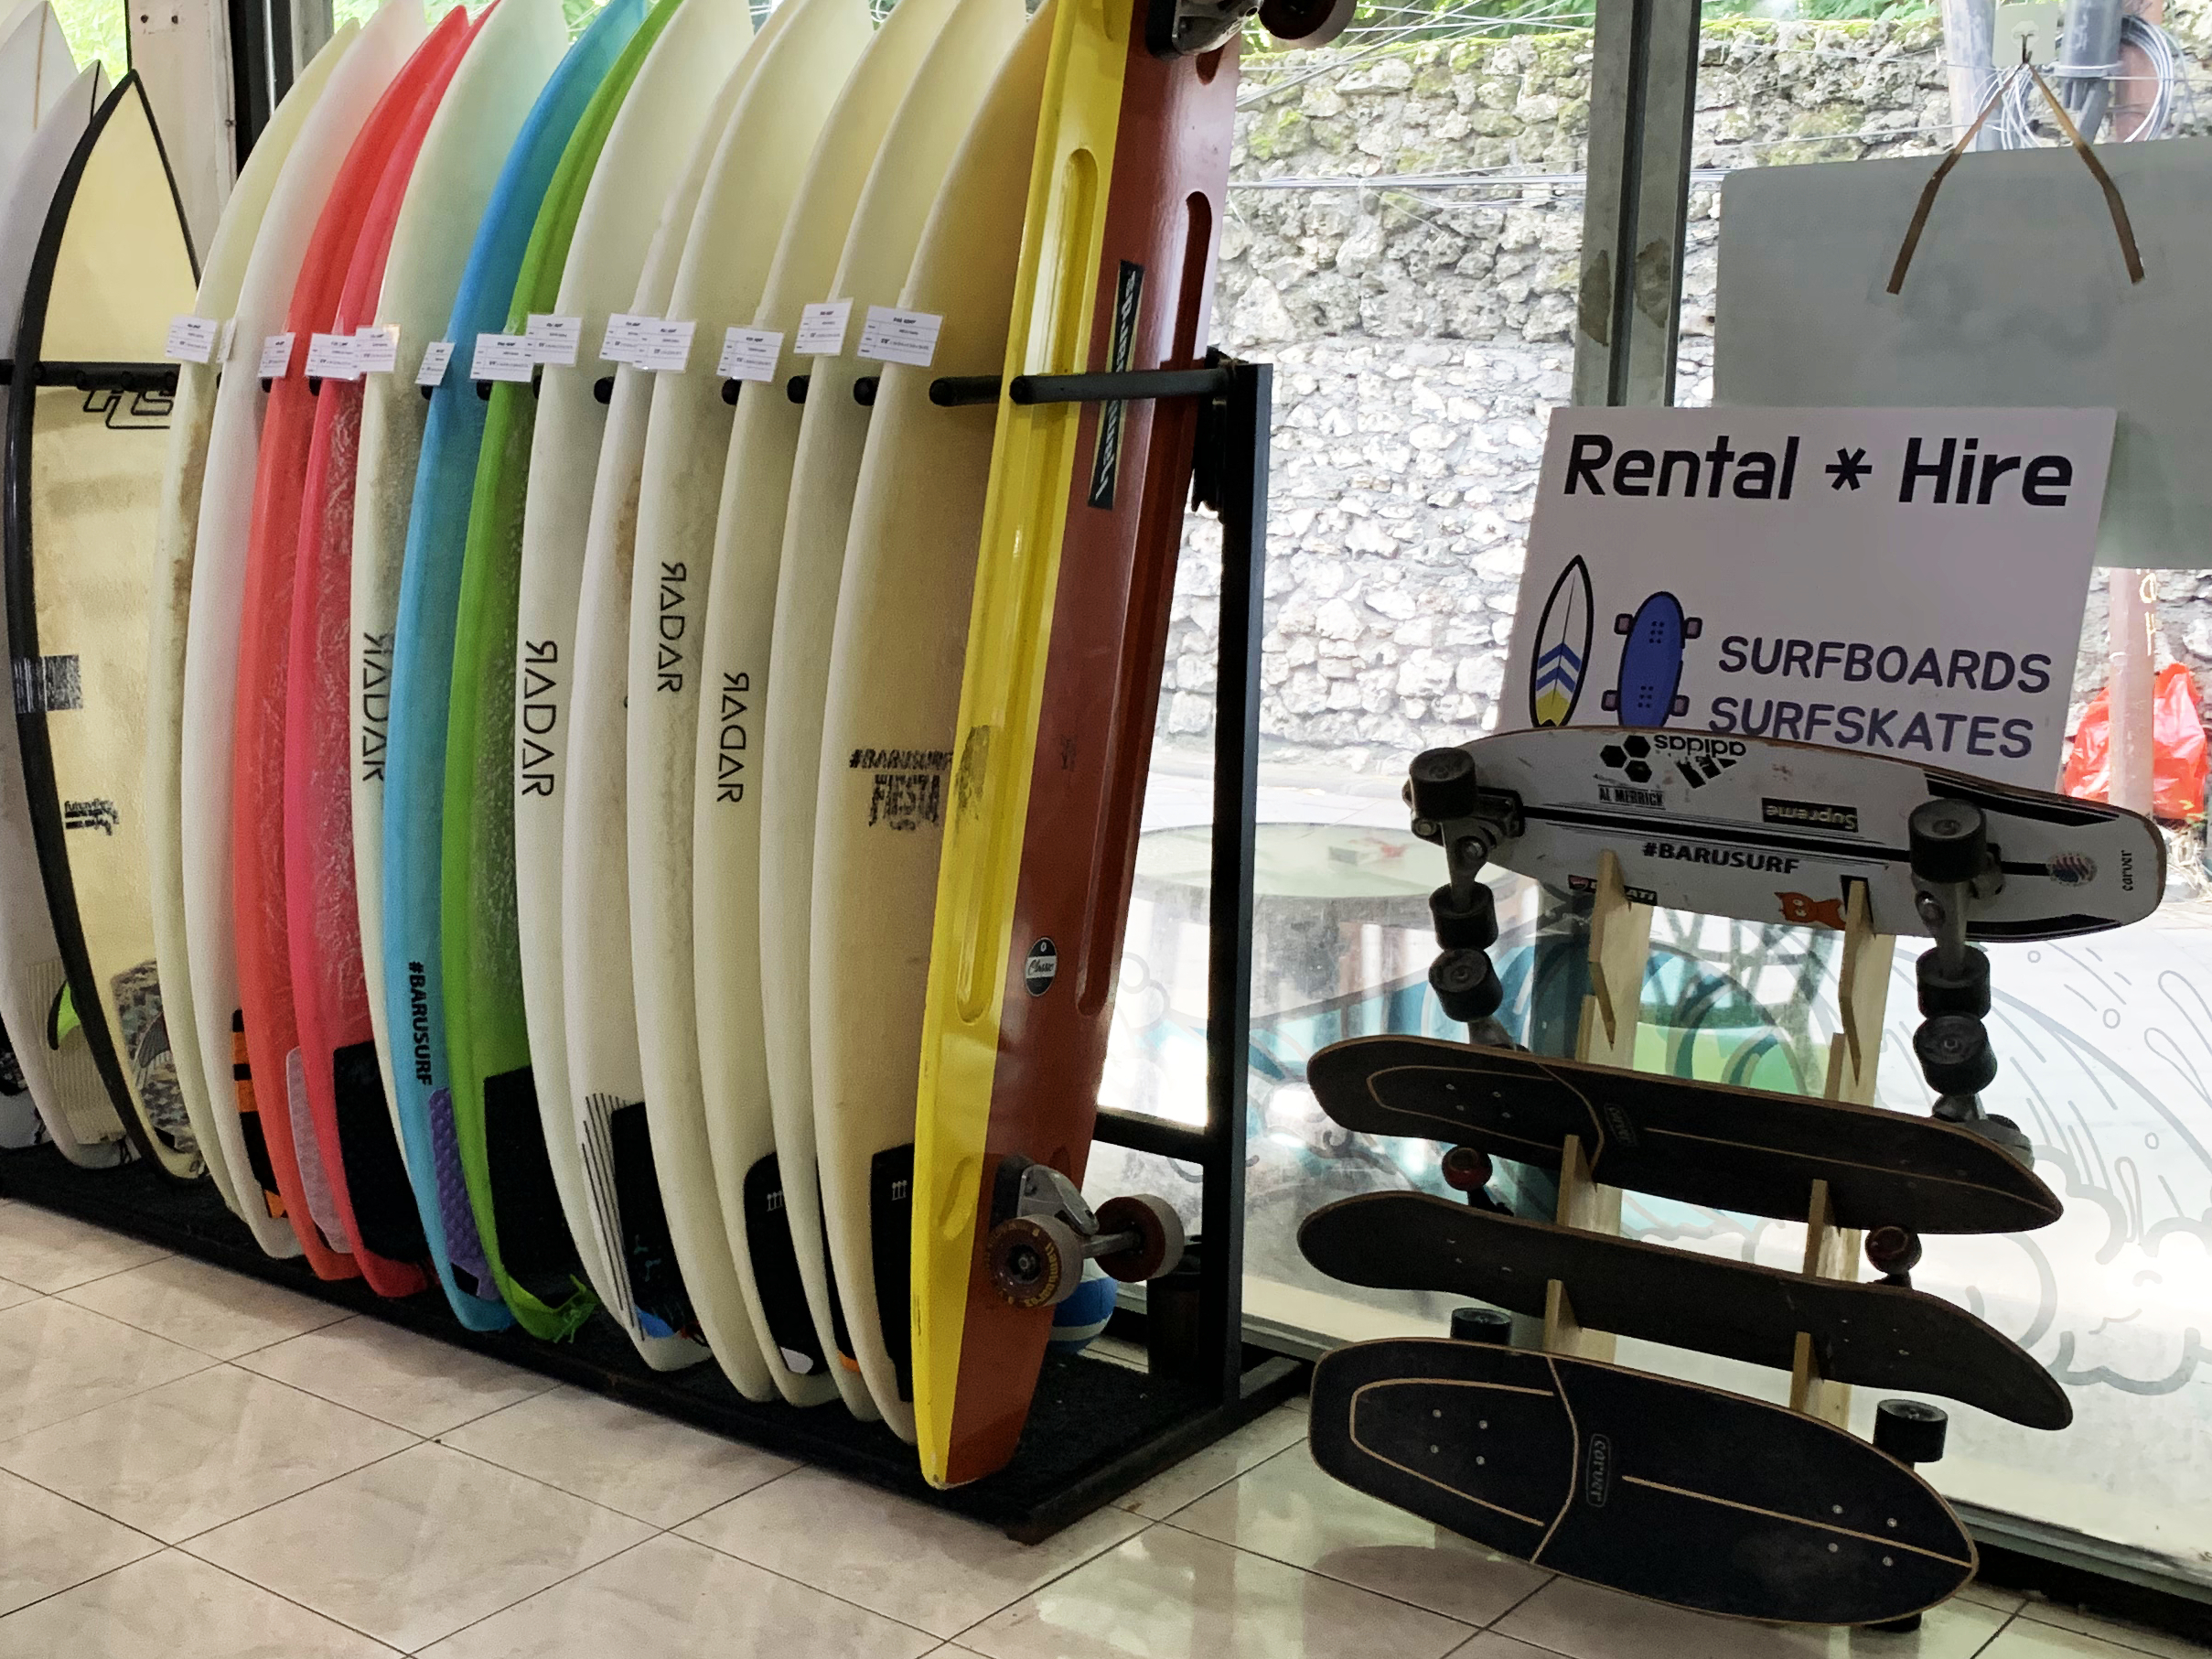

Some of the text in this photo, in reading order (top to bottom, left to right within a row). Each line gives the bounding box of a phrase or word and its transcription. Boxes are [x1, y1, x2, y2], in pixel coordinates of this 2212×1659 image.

[1563, 434, 1800, 500] Rental
[1898, 436, 2074, 507] Hire
[1718, 635, 2052, 695] SURFBOARDS
[1654, 734, 1746, 758] adidas
[1708, 696, 2035, 759] SURFSKATES
[1766, 803, 1858, 830] Supreme
[1642, 842, 1800, 874] #BARUSURF
[2120, 849, 2134, 892] carver
[408, 961, 433, 1086] #BARUSURF
[1590, 1439, 1606, 1503] carver
